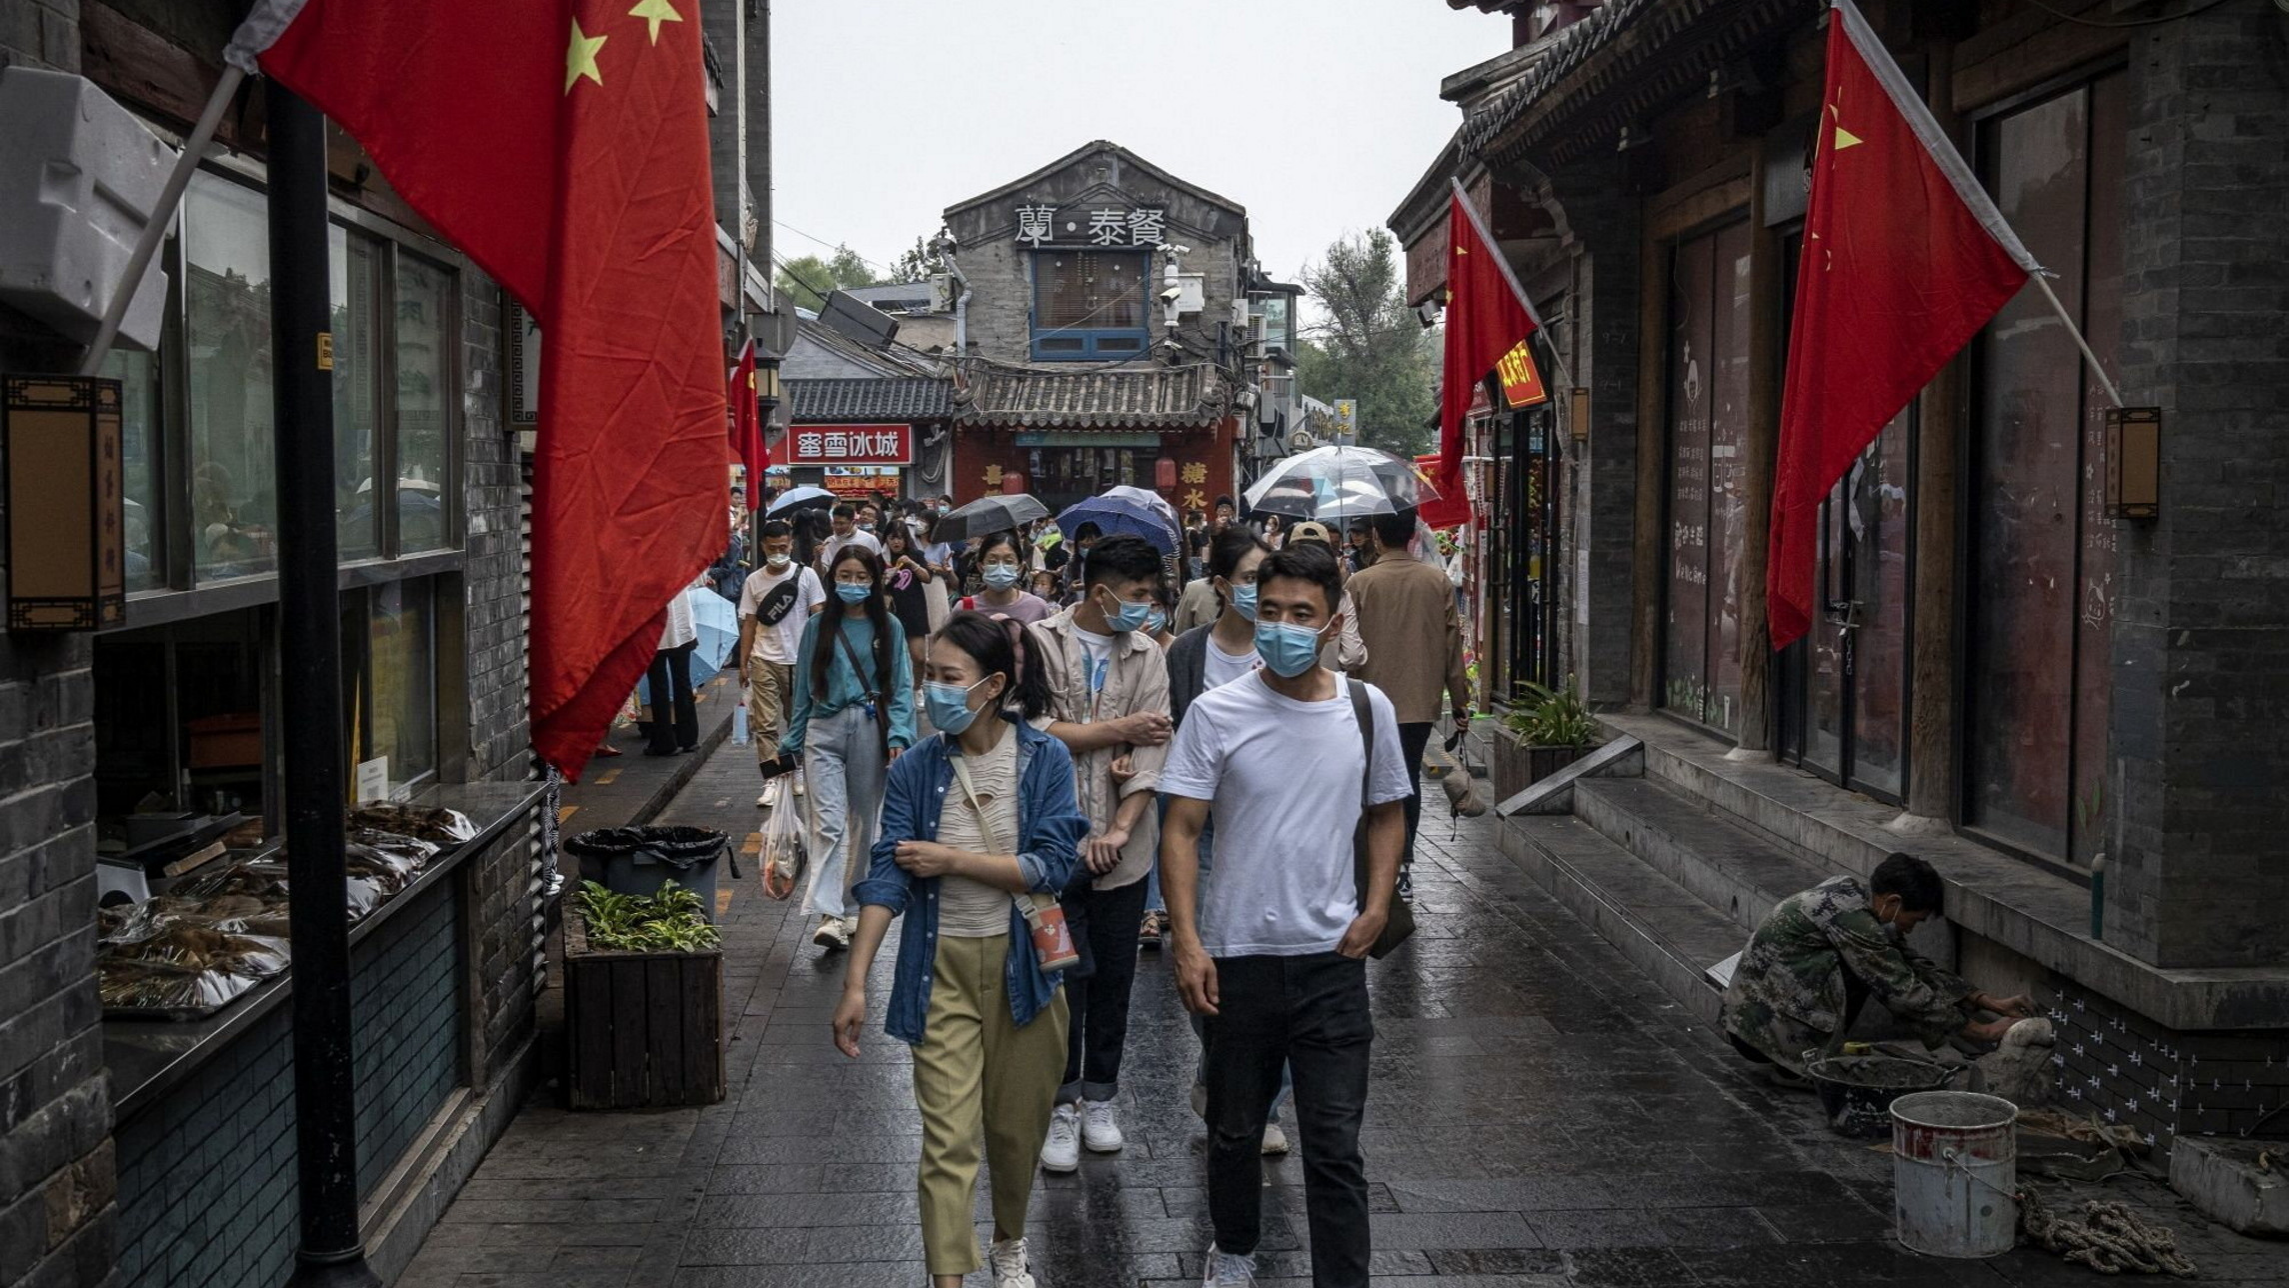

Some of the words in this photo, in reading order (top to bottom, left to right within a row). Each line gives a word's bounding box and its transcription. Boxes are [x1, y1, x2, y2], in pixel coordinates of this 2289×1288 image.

[798, 431, 898, 457] 蜜雪冰城
[767, 594, 794, 621] FILA
